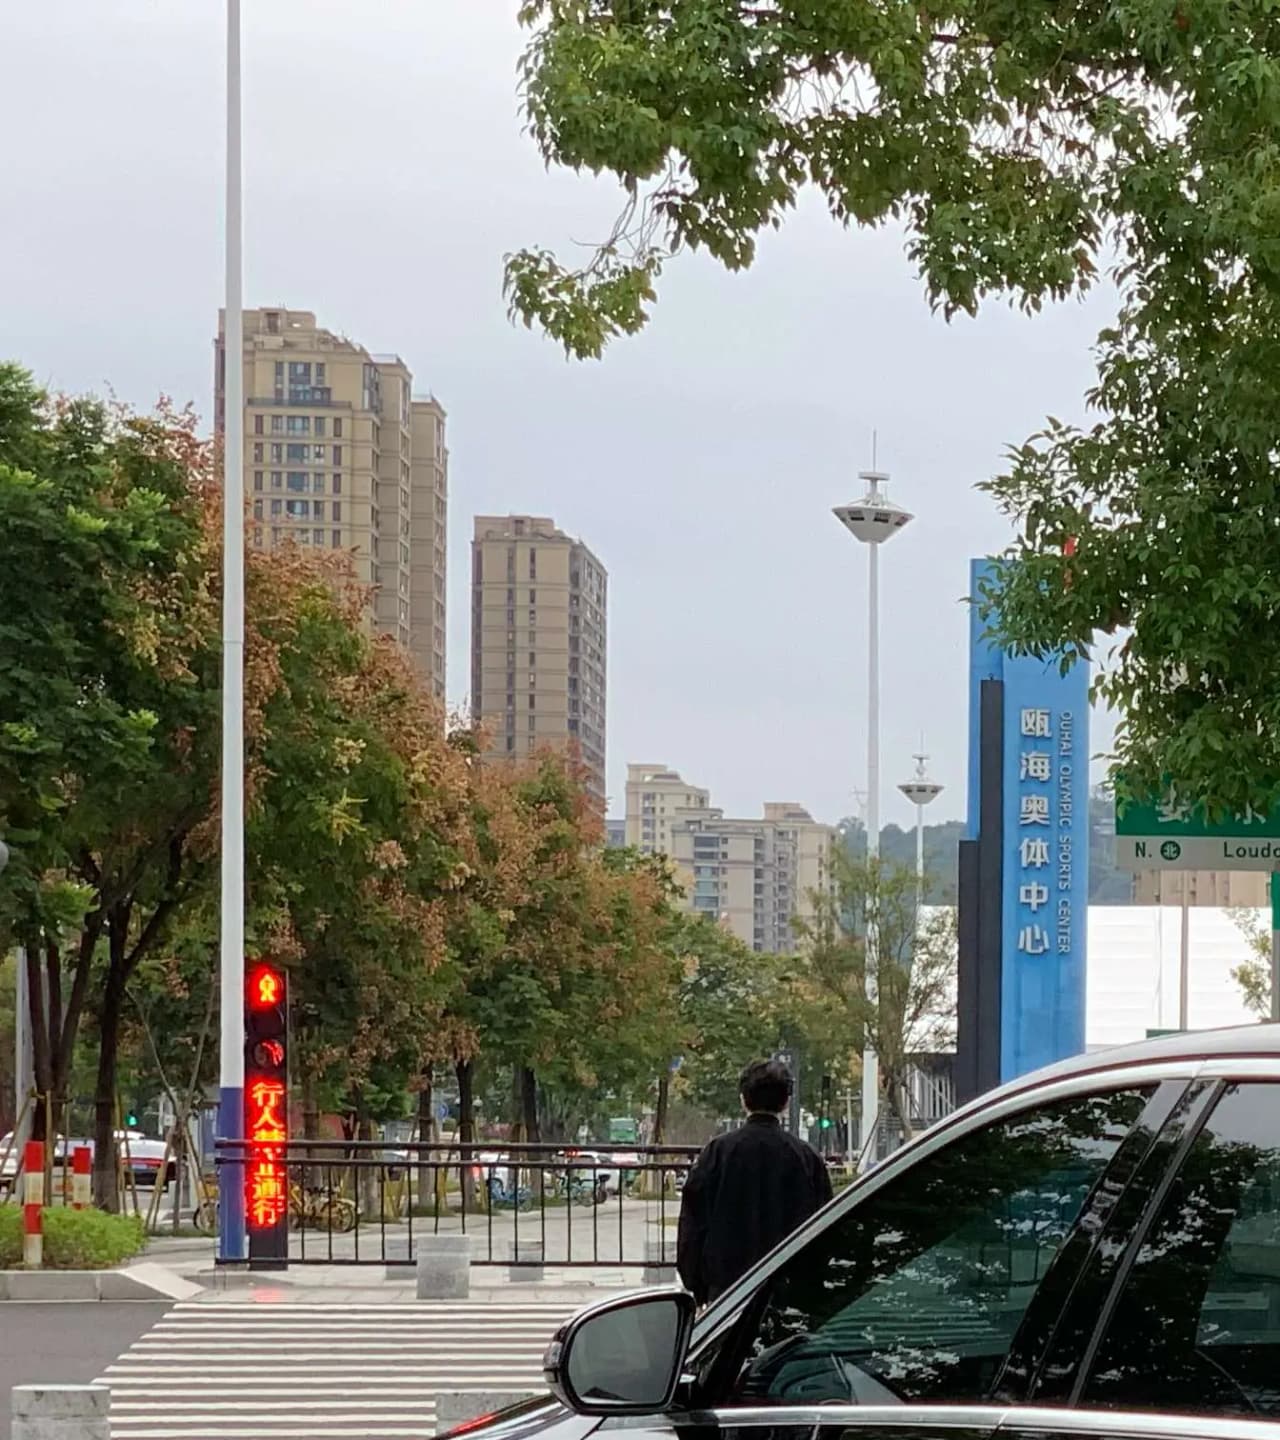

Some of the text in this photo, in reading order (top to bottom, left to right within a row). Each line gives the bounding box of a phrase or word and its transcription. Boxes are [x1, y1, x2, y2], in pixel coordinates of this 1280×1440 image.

[1018, 707, 1052, 955] 瓯海奥体中心
[1057, 711, 1074, 954] OUHAI OLYMPIC SPORTS CENTER
[1134, 841, 1153, 858] N.
